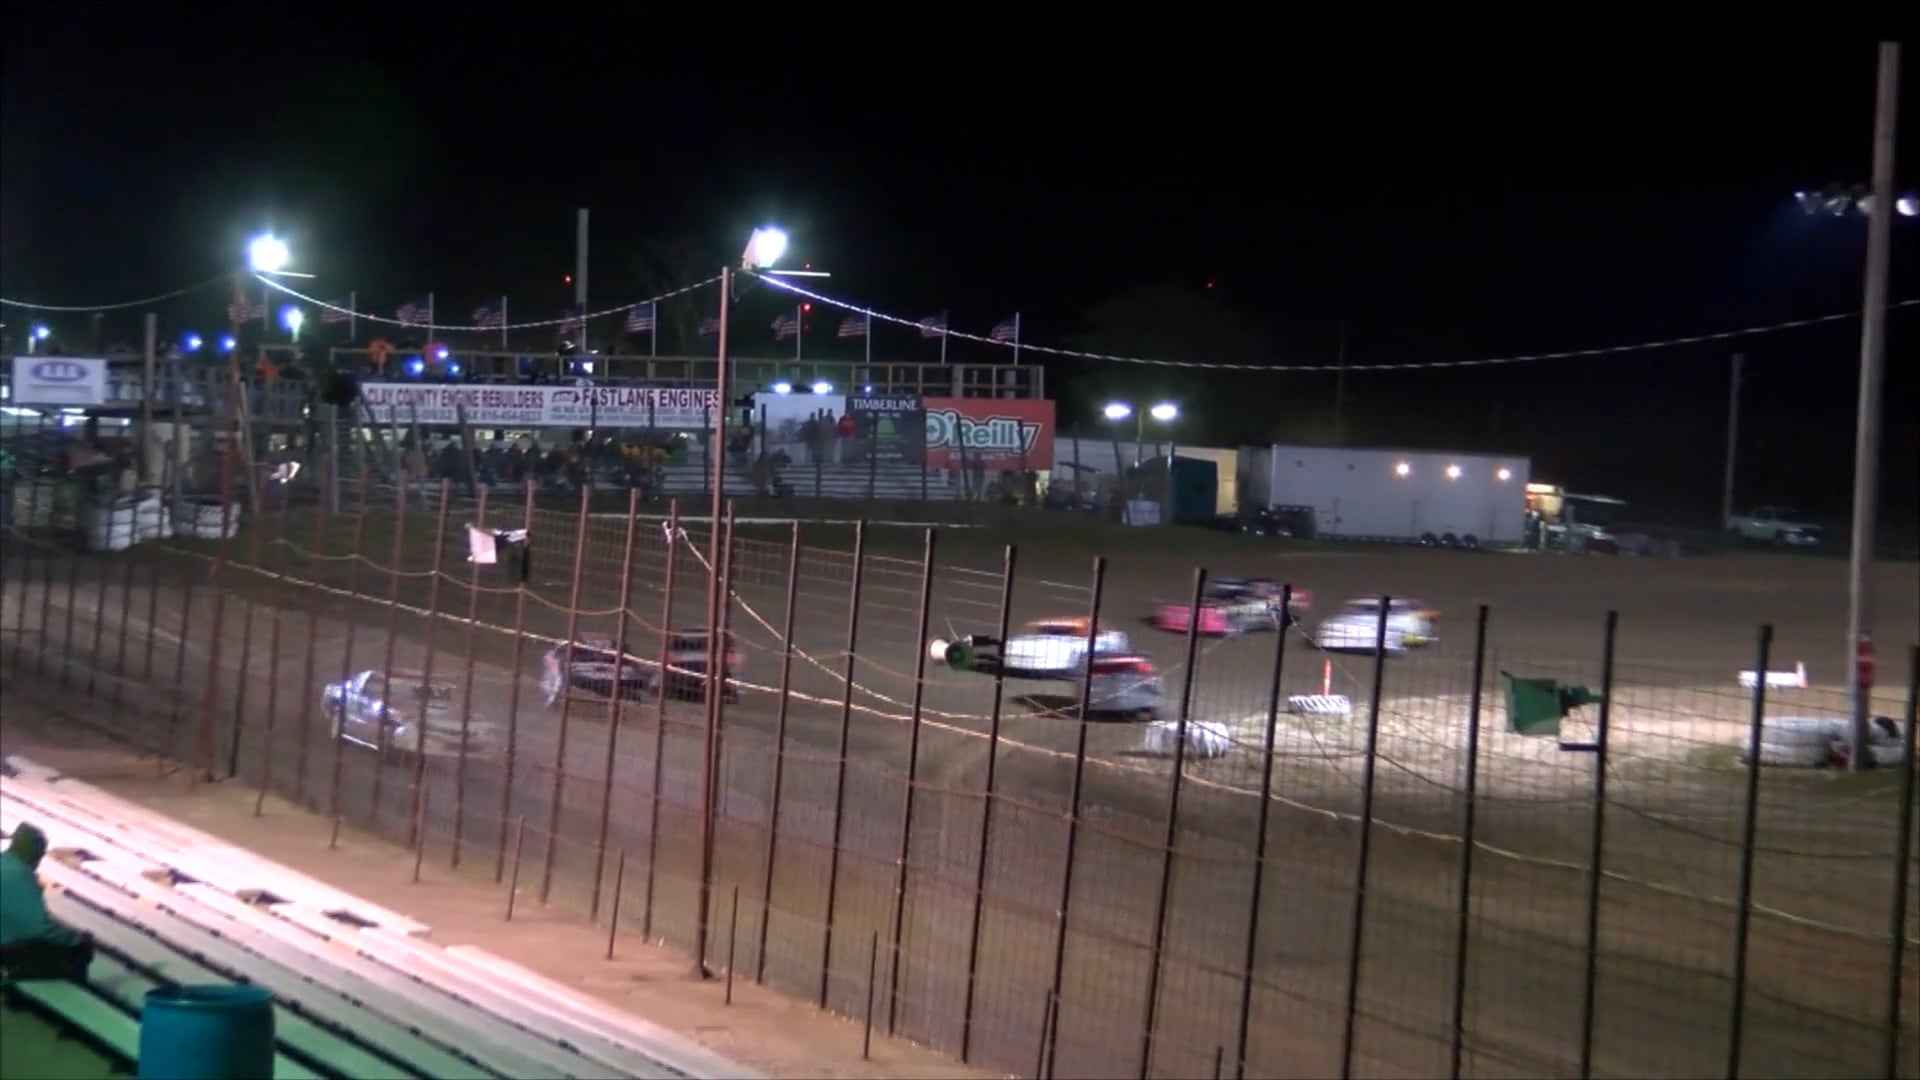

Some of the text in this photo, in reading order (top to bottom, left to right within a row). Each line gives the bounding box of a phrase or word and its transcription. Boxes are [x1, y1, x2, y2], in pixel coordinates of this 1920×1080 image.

[441, 389, 480, 408] ENGINE
[482, 390, 544, 409] REBUILDERS
[582, 388, 719, 409] FASTLANE ENGINES
[853, 398, 918, 411] TIMBERLINE
[926, 411, 1040, 456] O'Reilly
